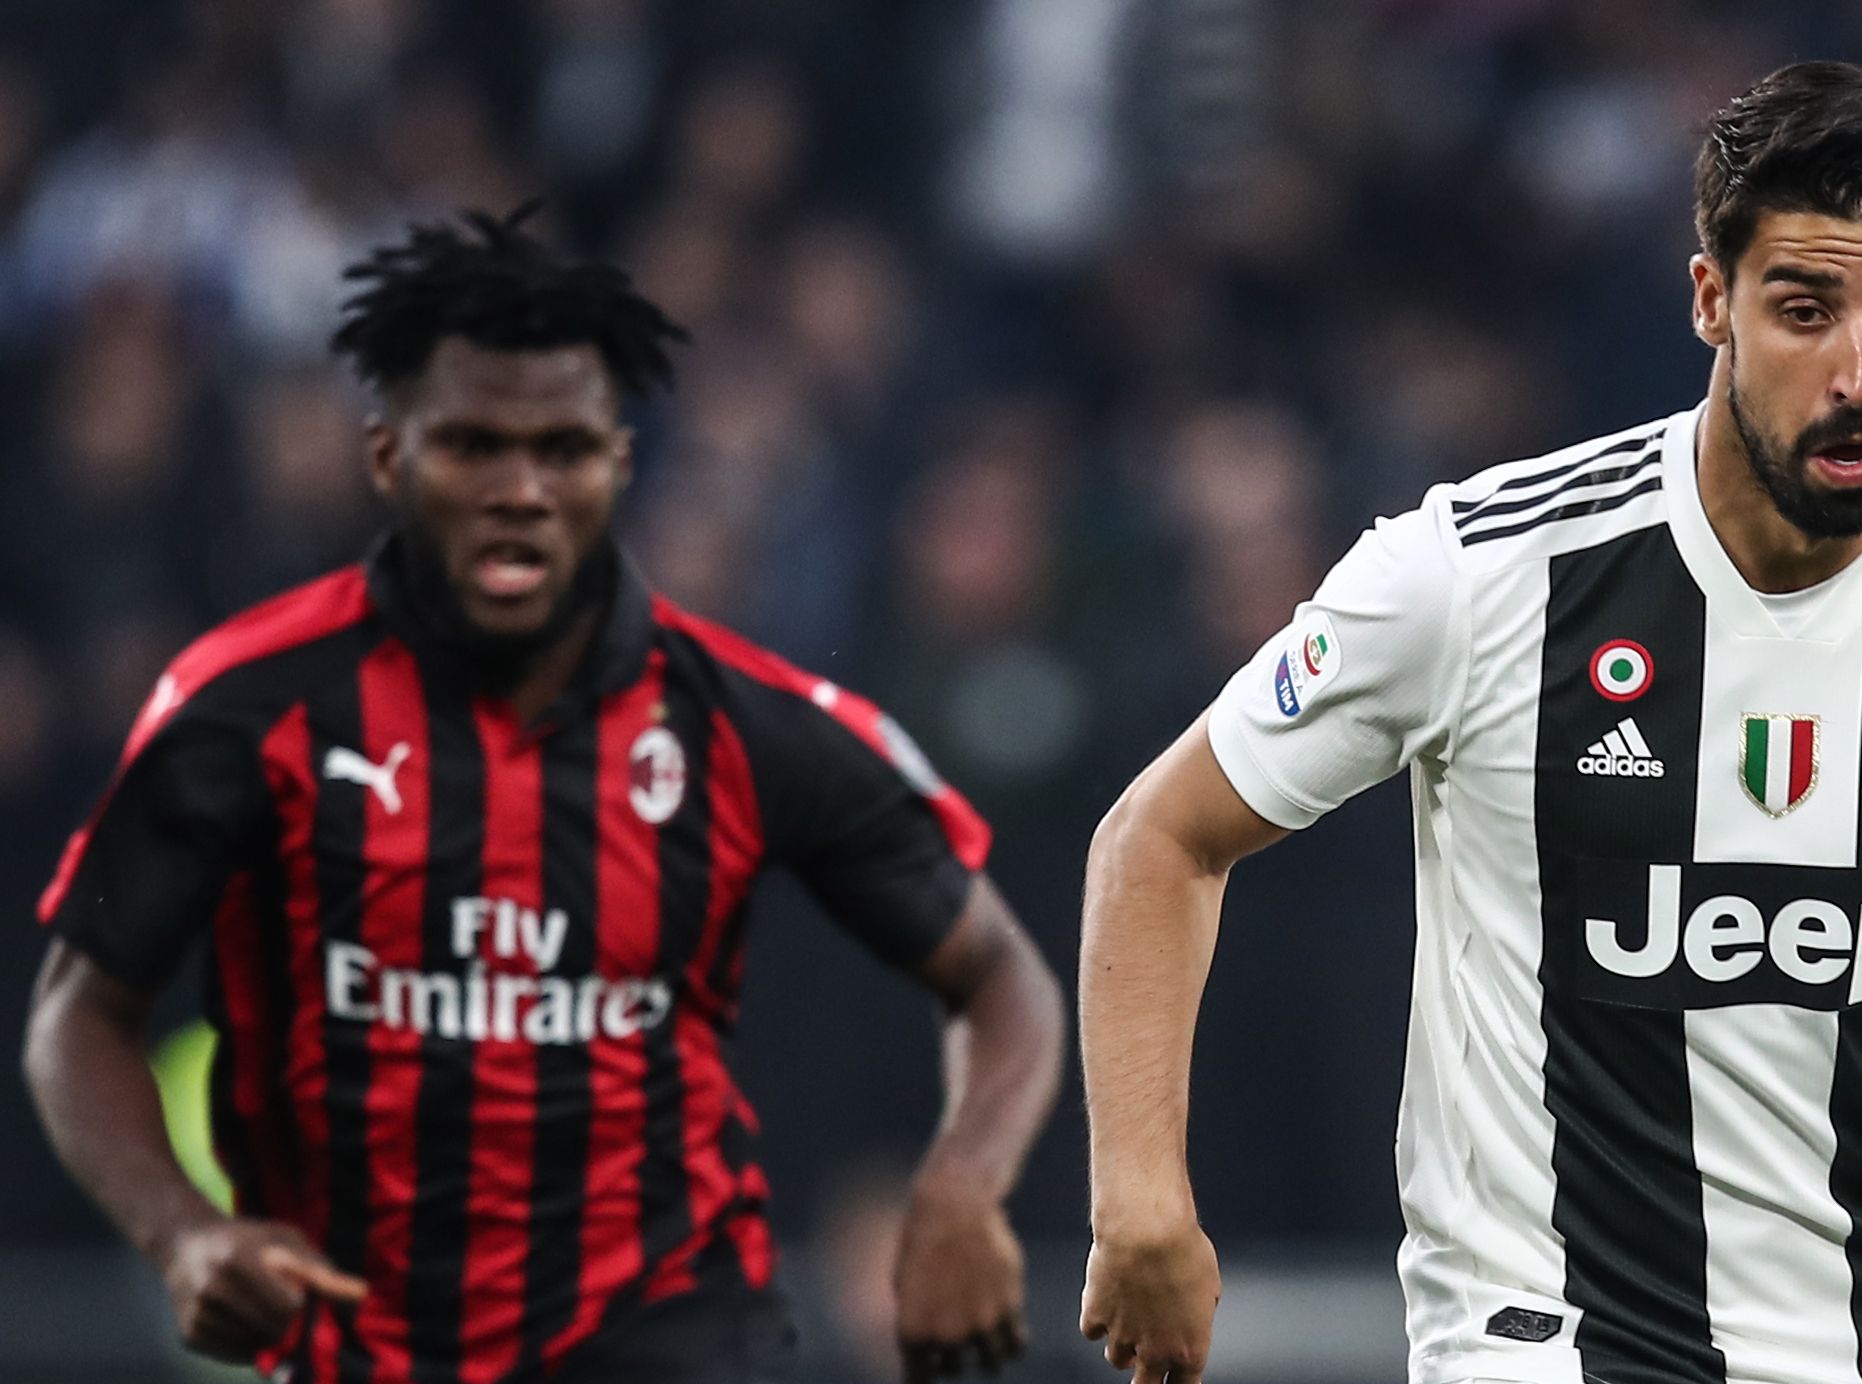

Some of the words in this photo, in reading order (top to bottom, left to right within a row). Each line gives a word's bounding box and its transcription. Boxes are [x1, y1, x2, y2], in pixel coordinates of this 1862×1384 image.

[1279, 677, 1295, 711] TIM
[1577, 754, 1665, 778] adidas
[451, 896, 569, 971] Fly
